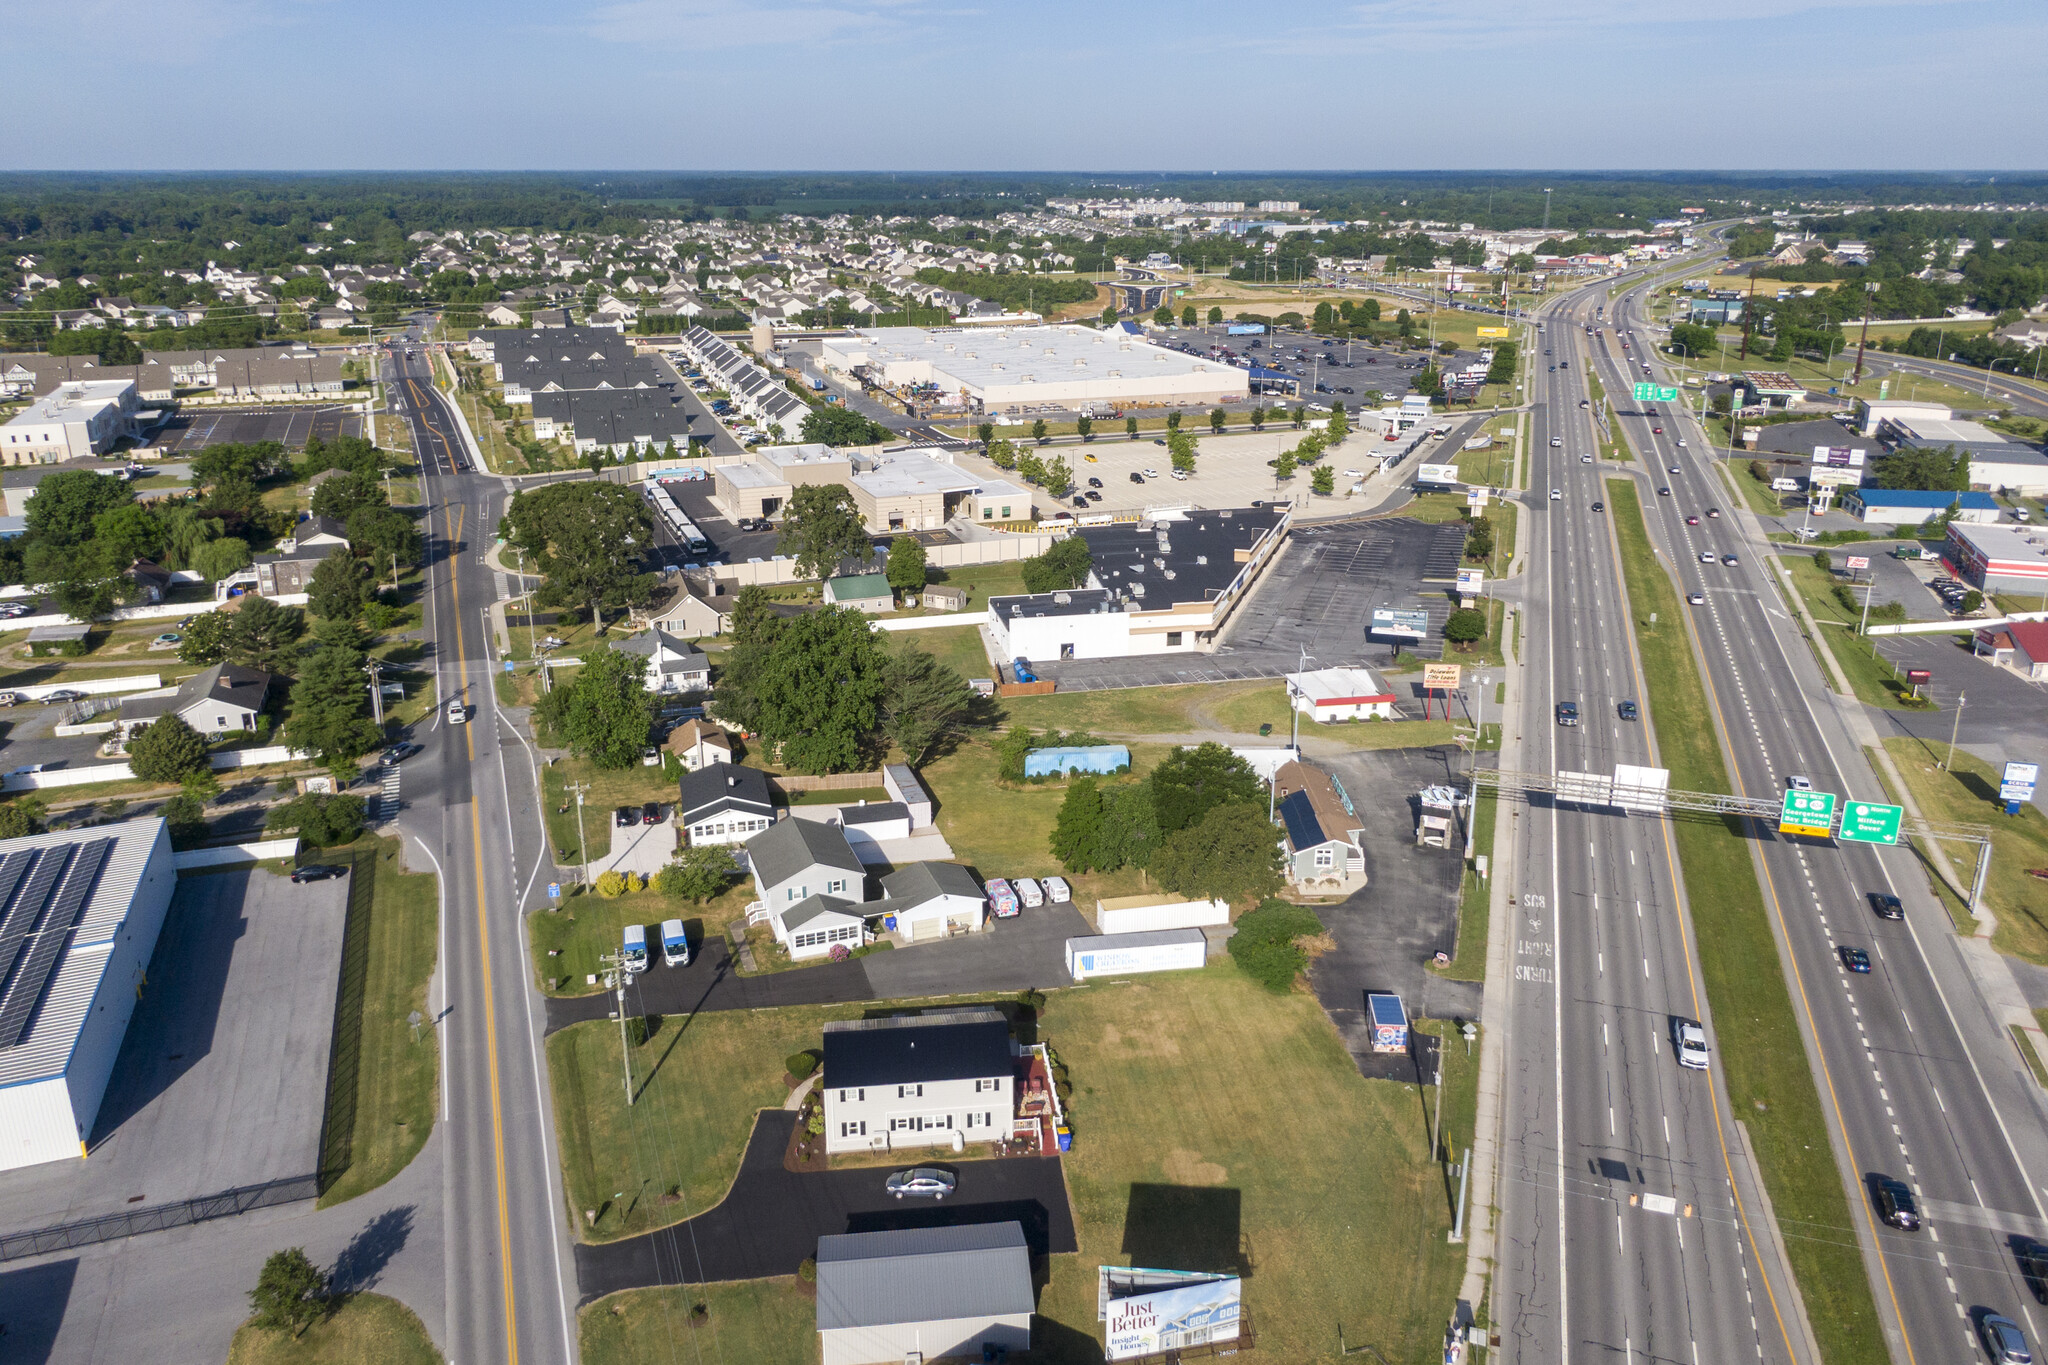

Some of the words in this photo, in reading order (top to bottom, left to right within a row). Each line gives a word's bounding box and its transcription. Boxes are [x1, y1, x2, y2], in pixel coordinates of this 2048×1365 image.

[1785, 809, 1829, 819] Georgetown
[1784, 816, 1799, 825] Bay
[1802, 817, 1828, 827] Bridge
[1857, 817, 1886, 827] Milford
[1858, 824, 1881, 833] Dover
[1524, 894, 1546, 908] BUS
[1517, 940, 1552, 957] RIGHT
[1515, 965, 1552, 984] TURNS
[1122, 1300, 1154, 1318] Just
[1112, 1314, 1160, 1333] Better
[1111, 1334, 1139, 1345] Insight
[1120, 1342, 1148, 1351] Homes
